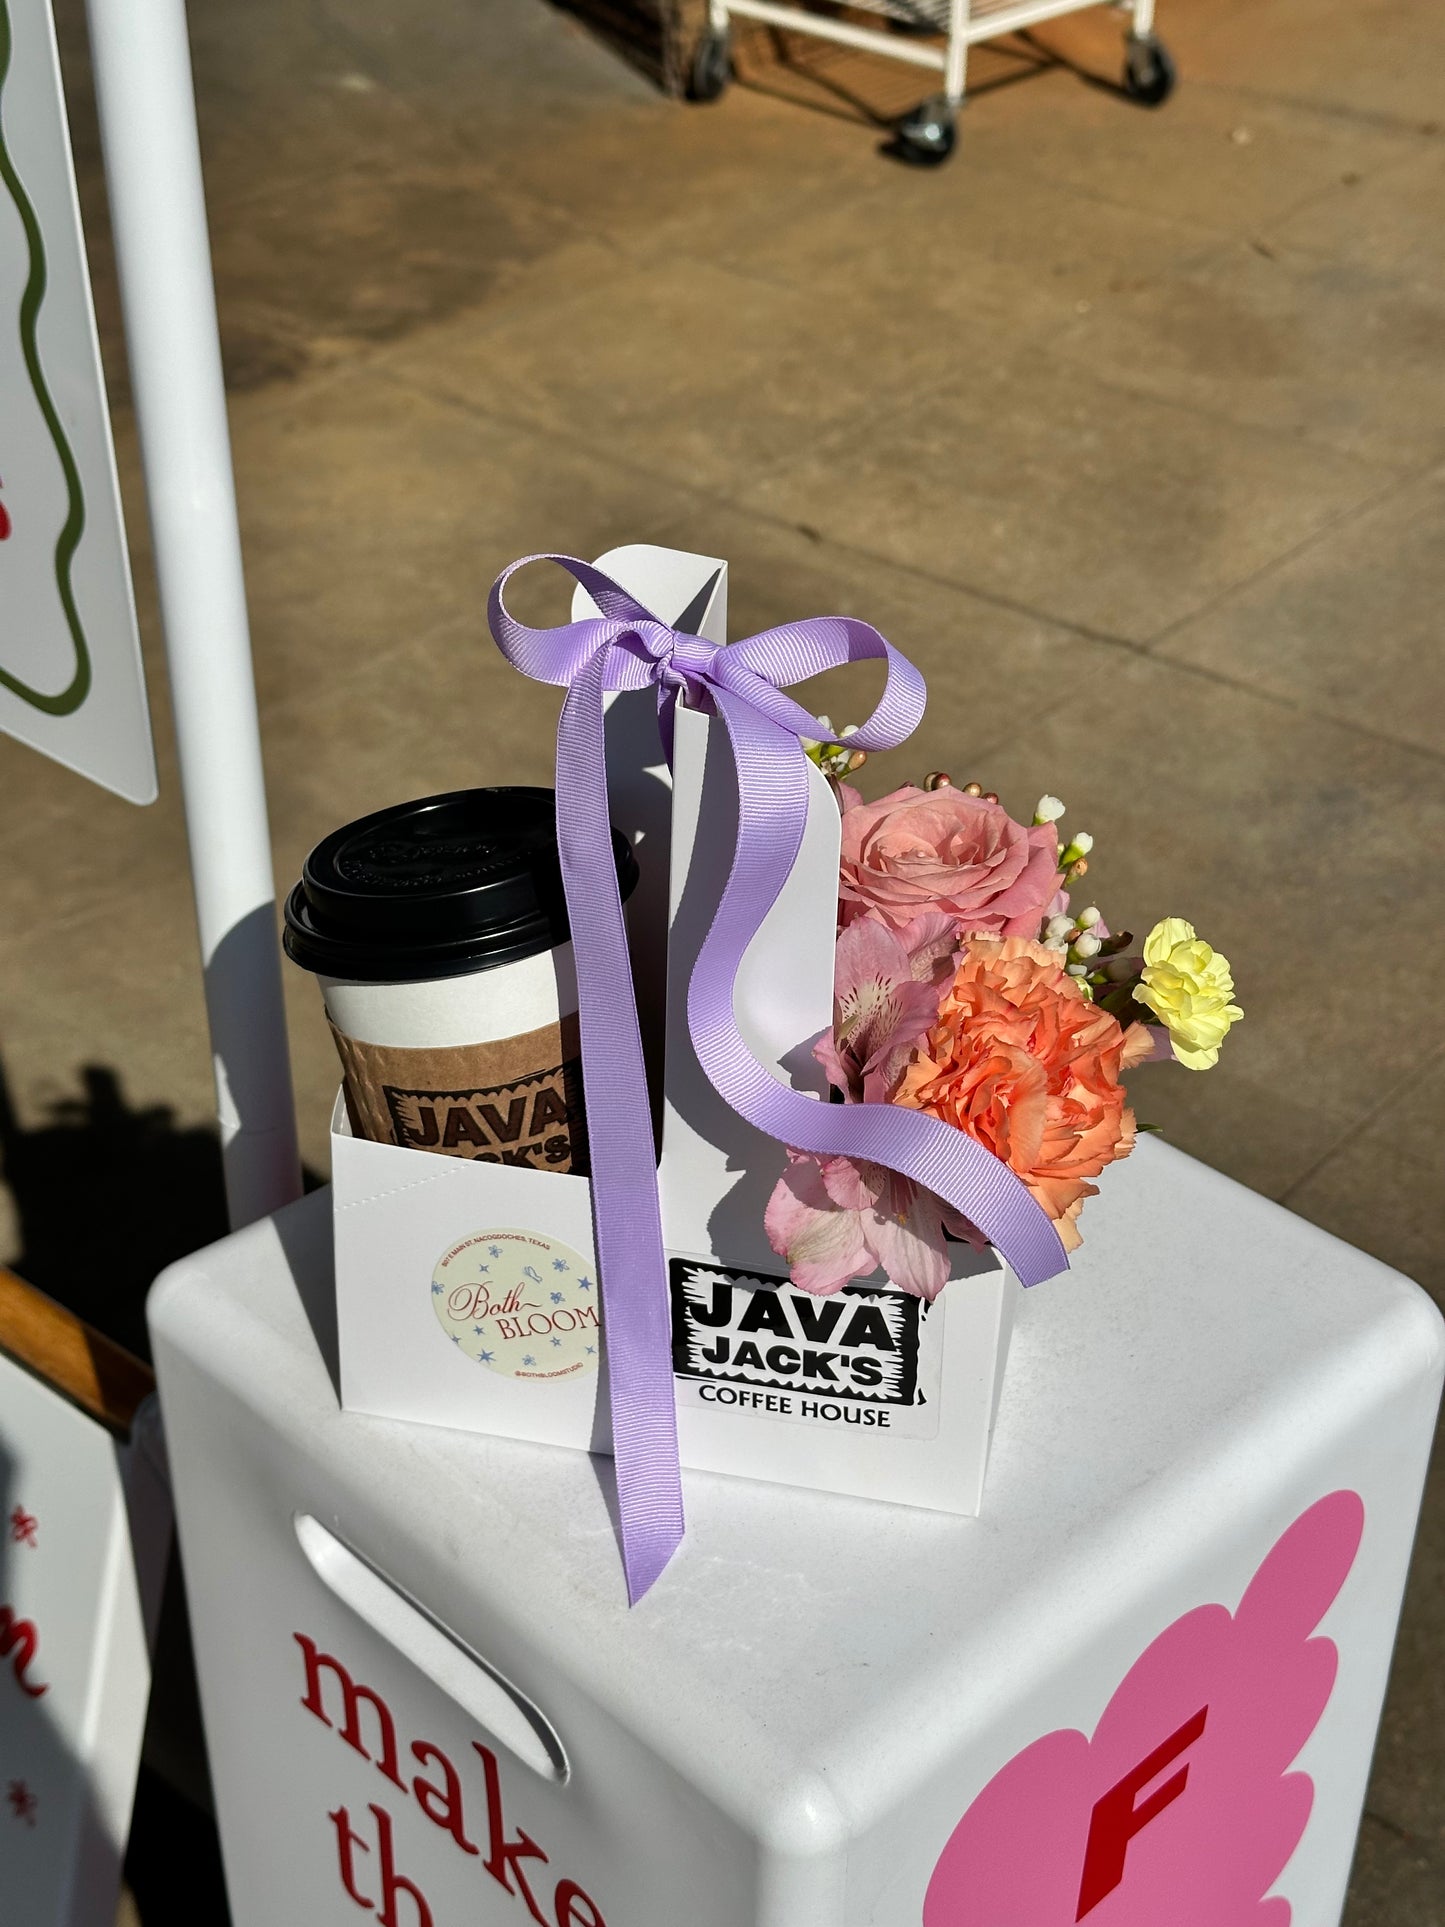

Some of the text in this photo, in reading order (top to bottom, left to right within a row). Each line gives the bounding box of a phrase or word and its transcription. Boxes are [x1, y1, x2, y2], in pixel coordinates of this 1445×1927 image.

[406, 1086, 572, 1148] JAVA
[451, 1244, 466, 1255] MAIN
[528, 1237, 551, 1250] TEXAS
[447, 1281, 542, 1322] Both
[495, 1305, 602, 1340] BLOOM
[689, 1281, 898, 1352] JAVA
[701, 1336, 885, 1387] JACK'S
[698, 1384, 891, 1428] COFFEE HOUSE
